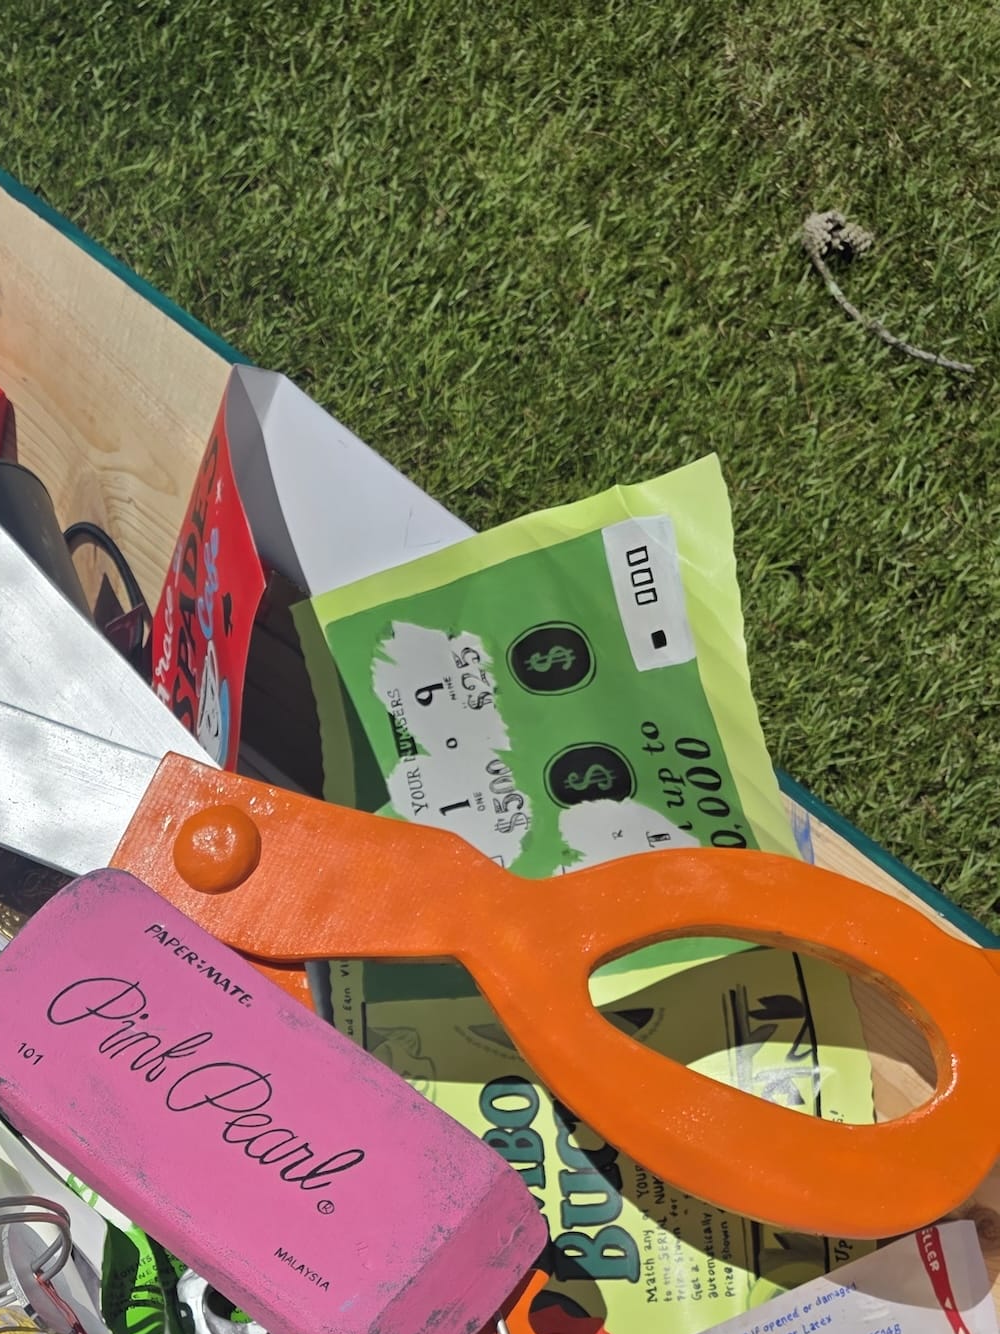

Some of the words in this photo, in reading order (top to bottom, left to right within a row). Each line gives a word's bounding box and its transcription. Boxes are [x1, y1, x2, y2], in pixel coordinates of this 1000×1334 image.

[413, 679, 445, 708] 9
[442, 674, 458, 702] NINE
[640, 719, 666, 758] to
[412, 757, 429, 816] YOUR
[472, 790, 486, 813] ONE
[657, 766, 688, 809] up
[439, 798, 471, 818] 1
[16, 1040, 45, 1066] 101
[47, 976, 214, 1083] Pink
[165, 1061, 366, 1190] Pearl
[640, 1229, 655, 1251] any
[694, 1212, 725, 1298] automatically
[716, 1221, 734, 1260] shown
[273, 1245, 331, 1292] MALAYSIA
[642, 1259, 659, 1301] Match
[723, 1267, 737, 1296] Prize
